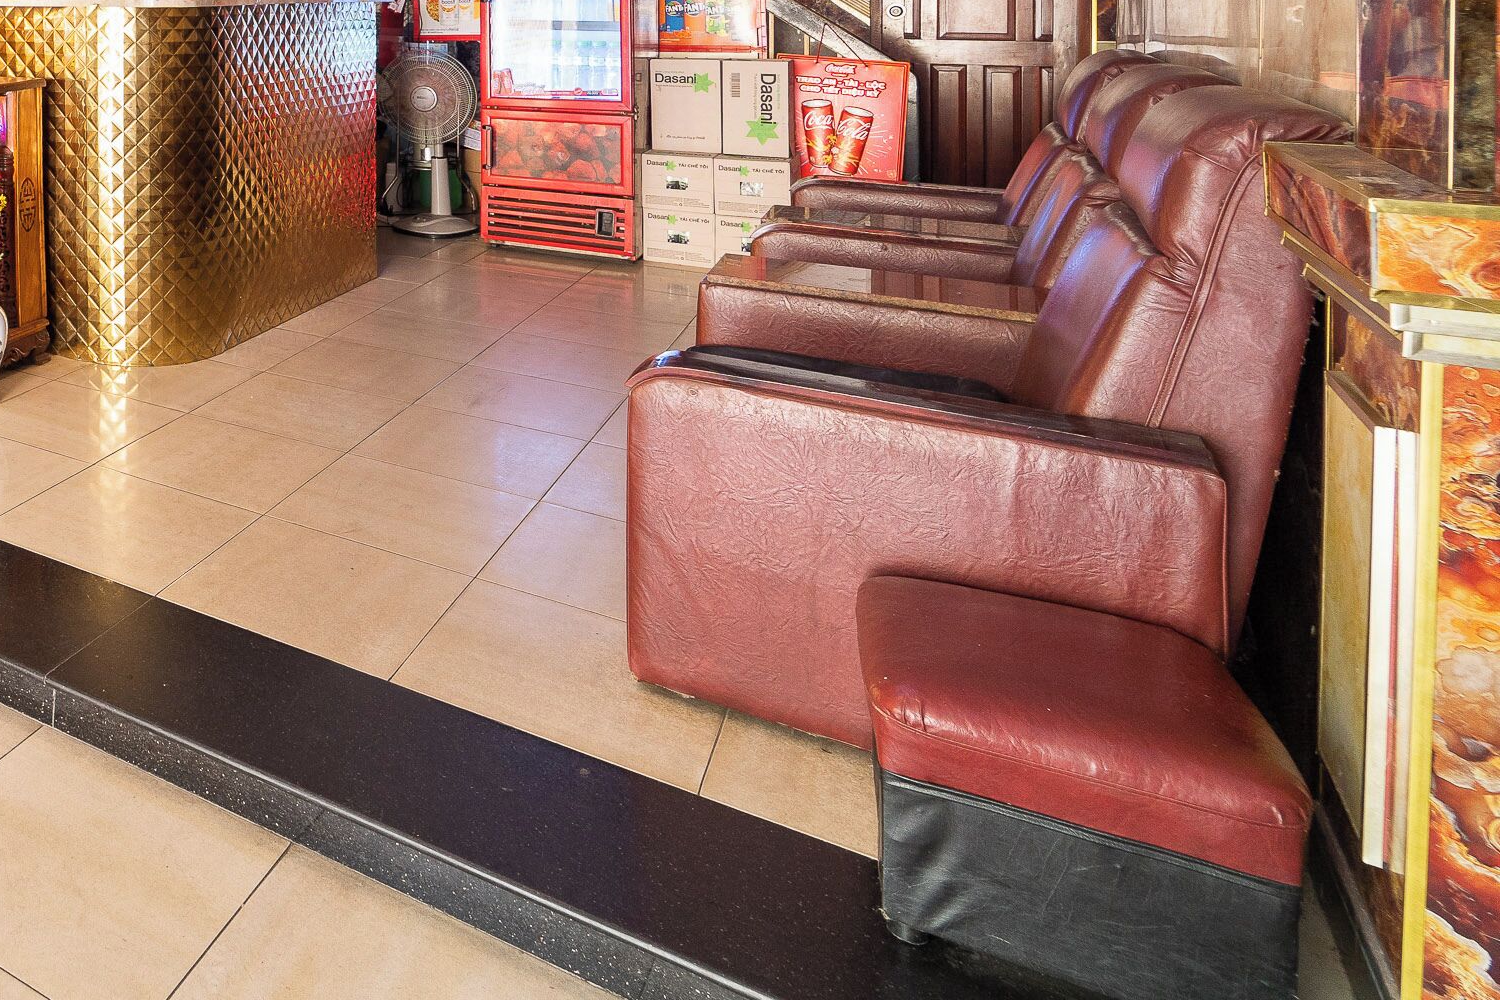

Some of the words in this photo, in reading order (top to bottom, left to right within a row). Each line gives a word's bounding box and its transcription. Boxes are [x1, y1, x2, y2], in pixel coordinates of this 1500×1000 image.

[655, 73, 697, 84] Dasani
[865, 80, 887, 90] LỘC
[800, 84, 822, 93] CHO
[841, 88, 865, 97] DIỆU
[865, 89, 880, 98] KỲ
[760, 73, 777, 125] Dasani
[804, 109, 834, 131] Coca
[837, 117, 871, 140] Cola
[646, 159, 669, 167] Dasani
[718, 164, 741, 172] Dasani
[647, 213, 670, 221] Dasani
[720, 220, 744, 228] Dasani
